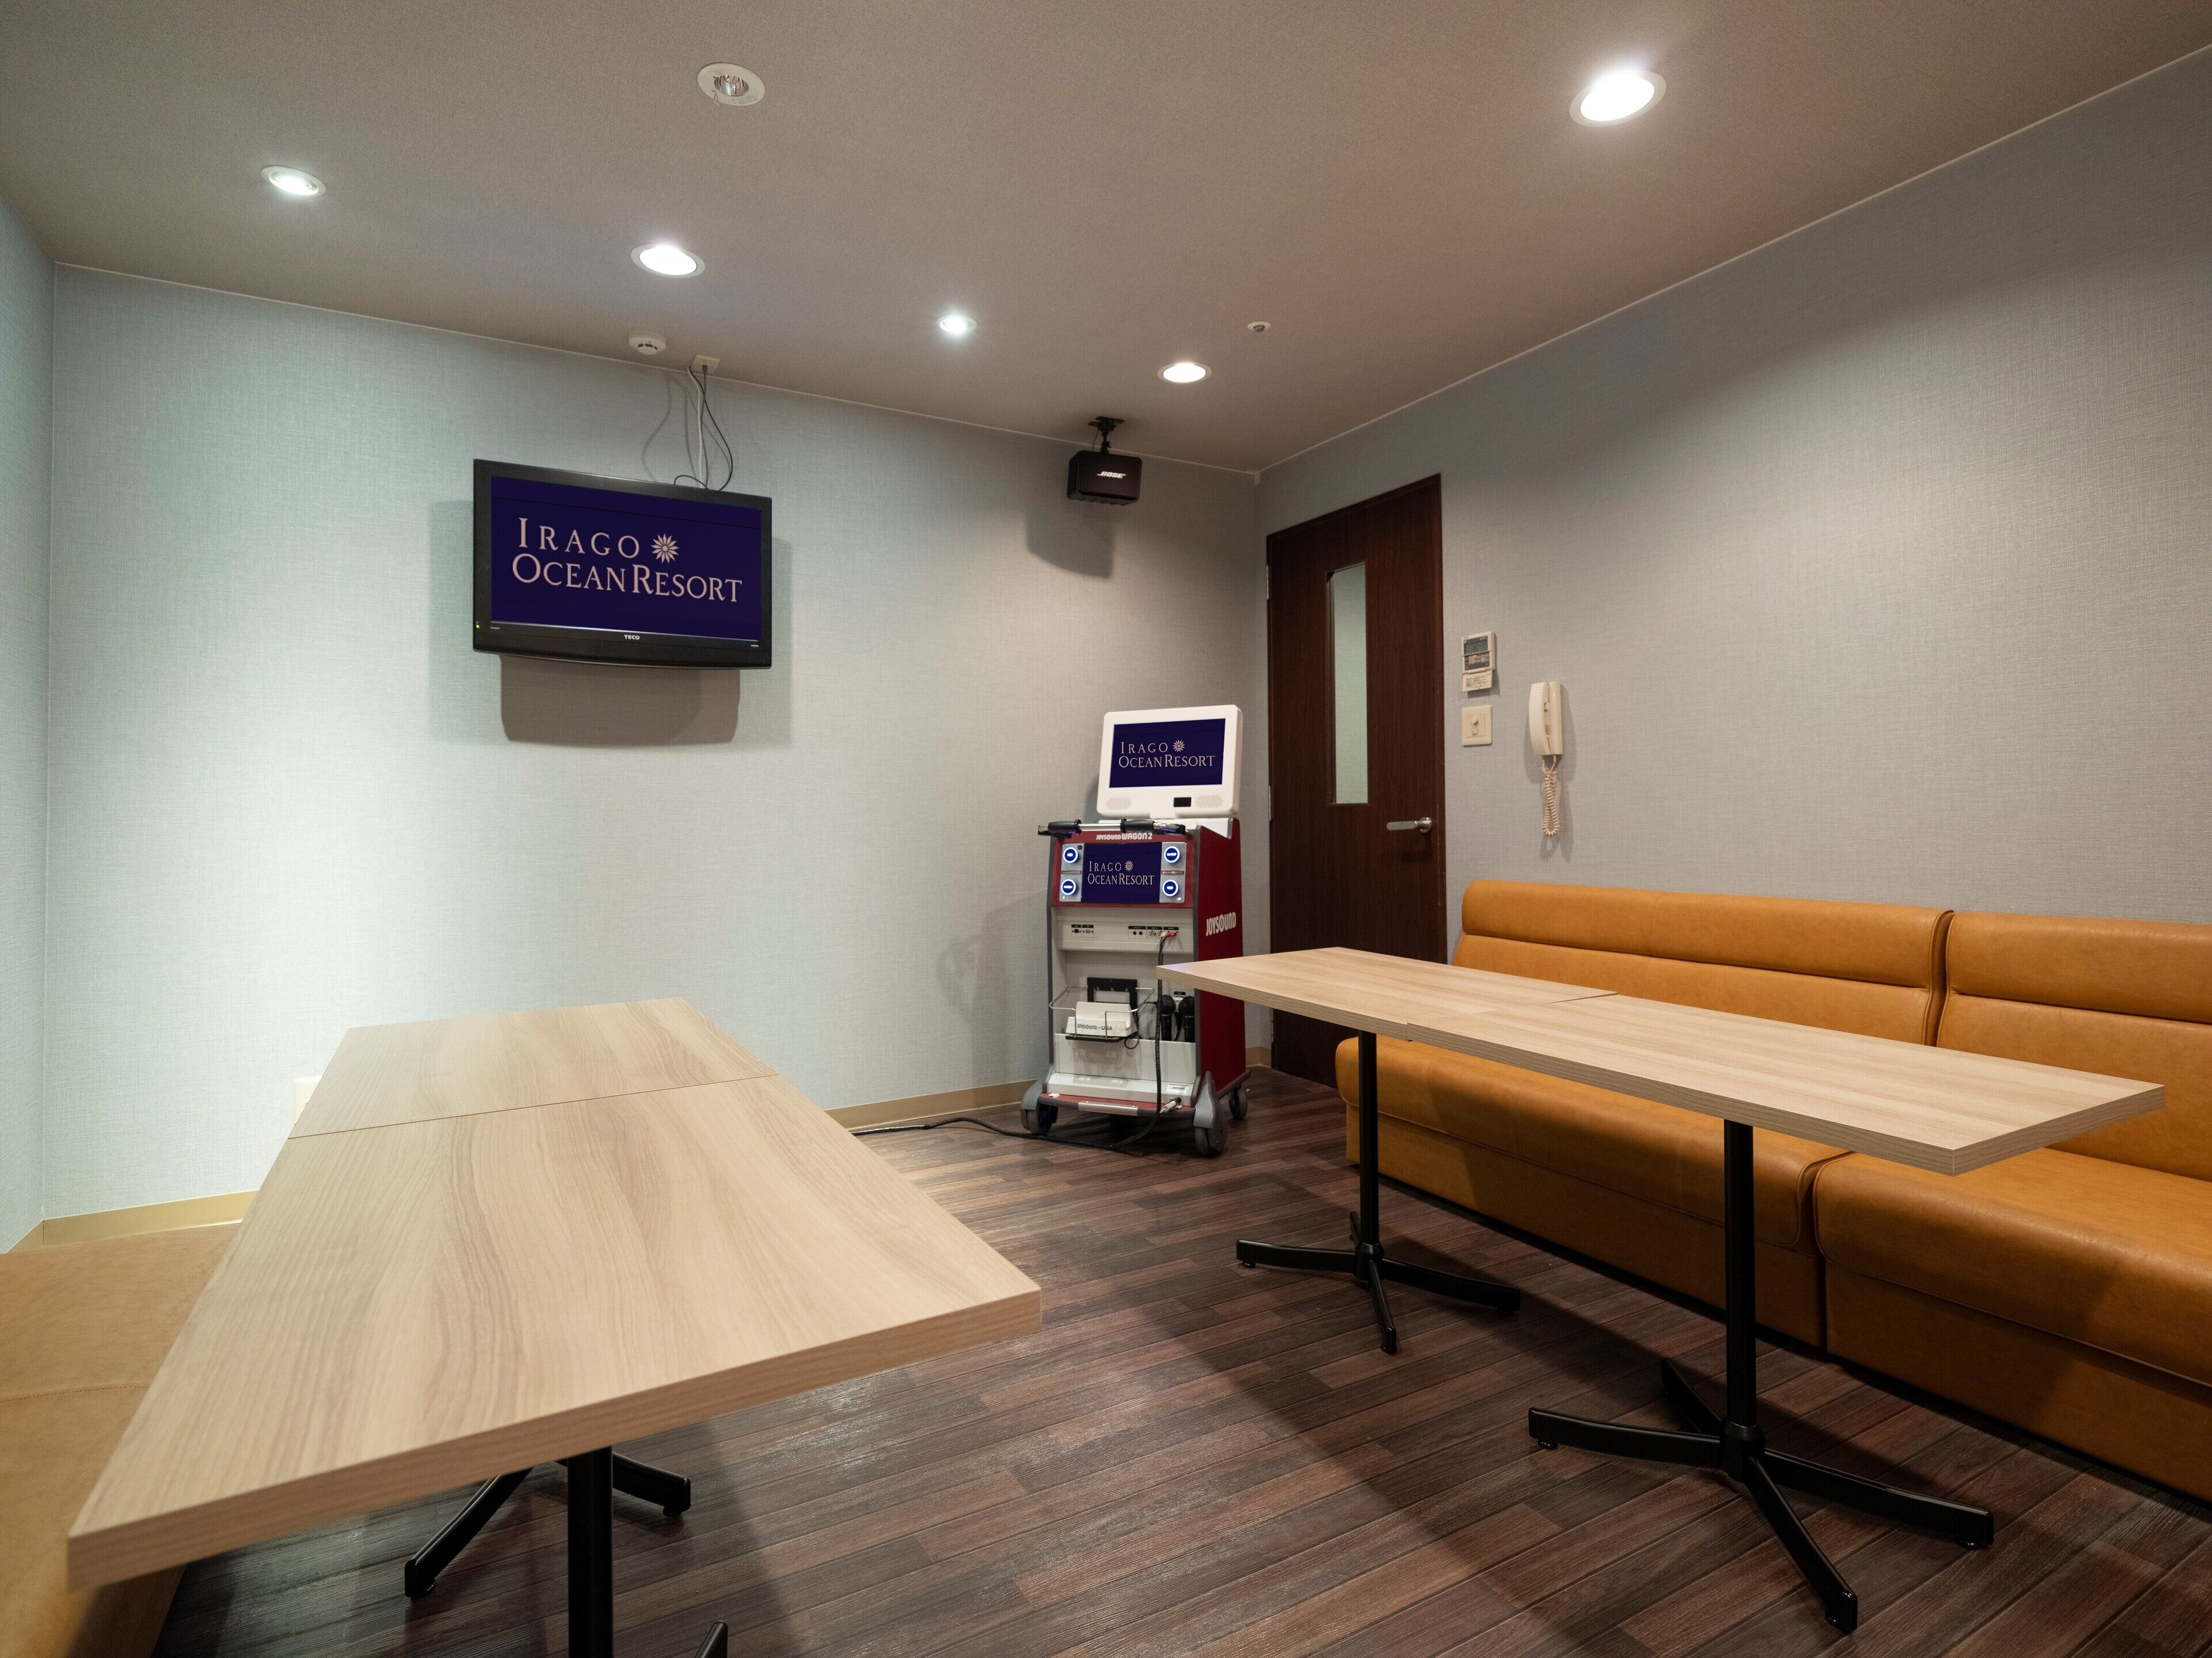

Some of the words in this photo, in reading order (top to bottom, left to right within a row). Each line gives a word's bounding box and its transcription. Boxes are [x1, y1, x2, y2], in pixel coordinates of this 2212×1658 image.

[518, 517, 639, 559] IRAGO
[1120, 742, 1168, 754] IRAGO
[1089, 860, 1122, 872] IRAGO
[1206, 912, 1236, 936] JOYSOUND
